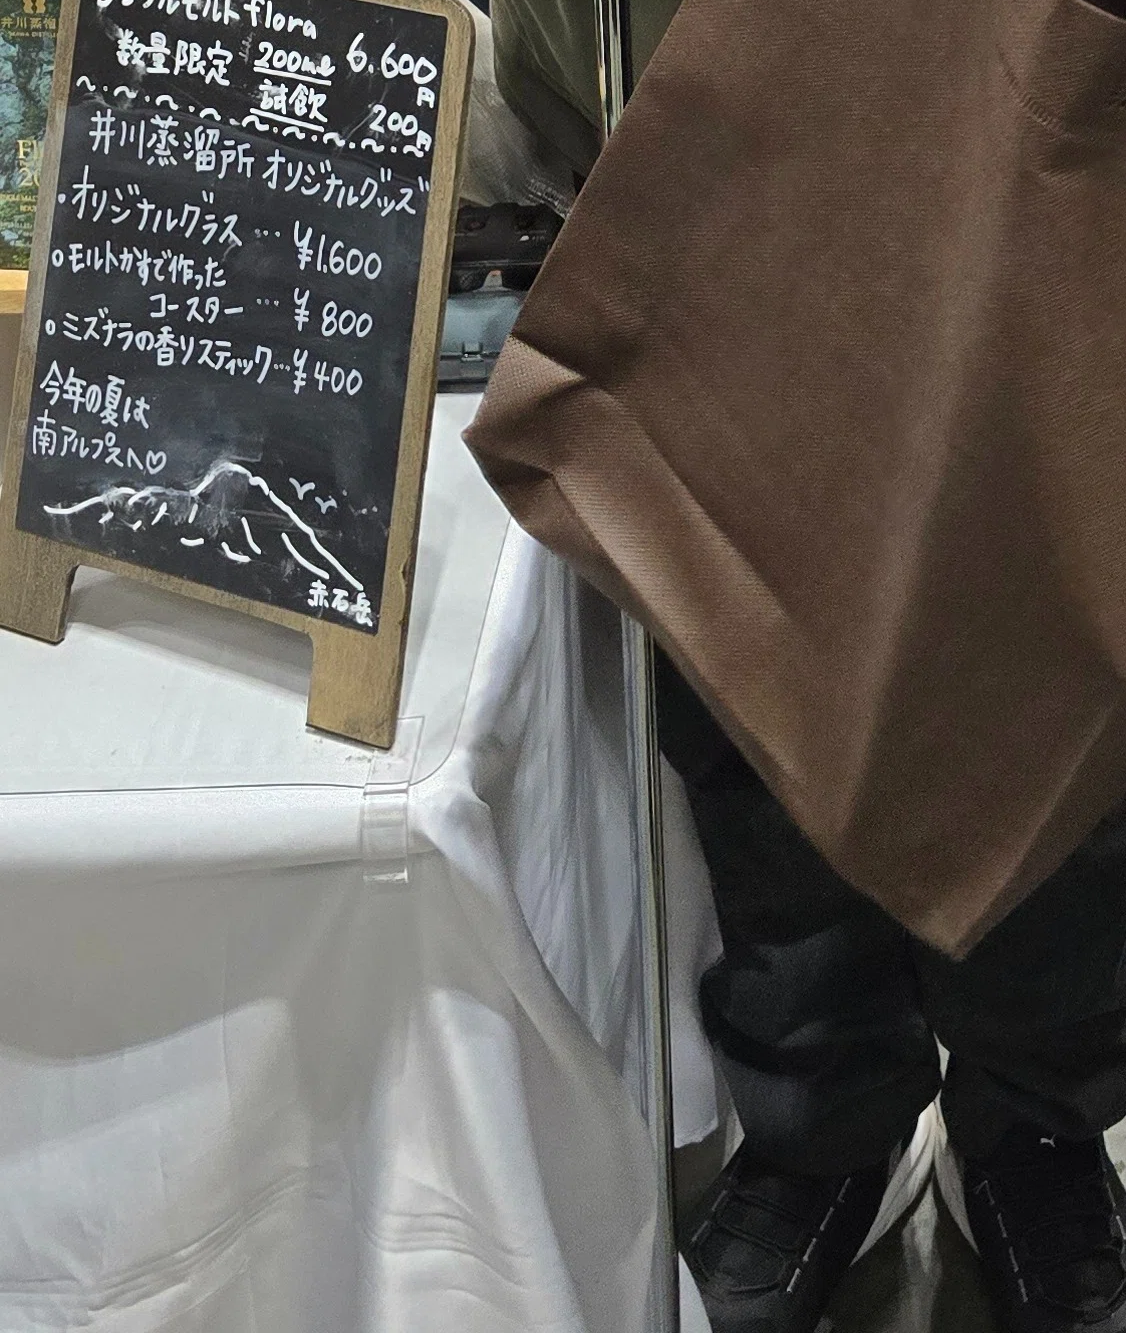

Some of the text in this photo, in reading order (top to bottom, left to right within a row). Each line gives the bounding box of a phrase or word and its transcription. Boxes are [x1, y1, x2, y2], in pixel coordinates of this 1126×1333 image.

[117, 27, 233, 85] 数量限定
[258, 79, 328, 123] 試飲
[89, 109, 430, 216] 井川蒸溜所 オリジナルグッズ
[72, 165, 242, 246] オリジナルグラス
[68, 240, 226, 290] モルトかすで作った
[149, 293, 243, 325] コースター
[40, 360, 150, 429] 今年の夏は
